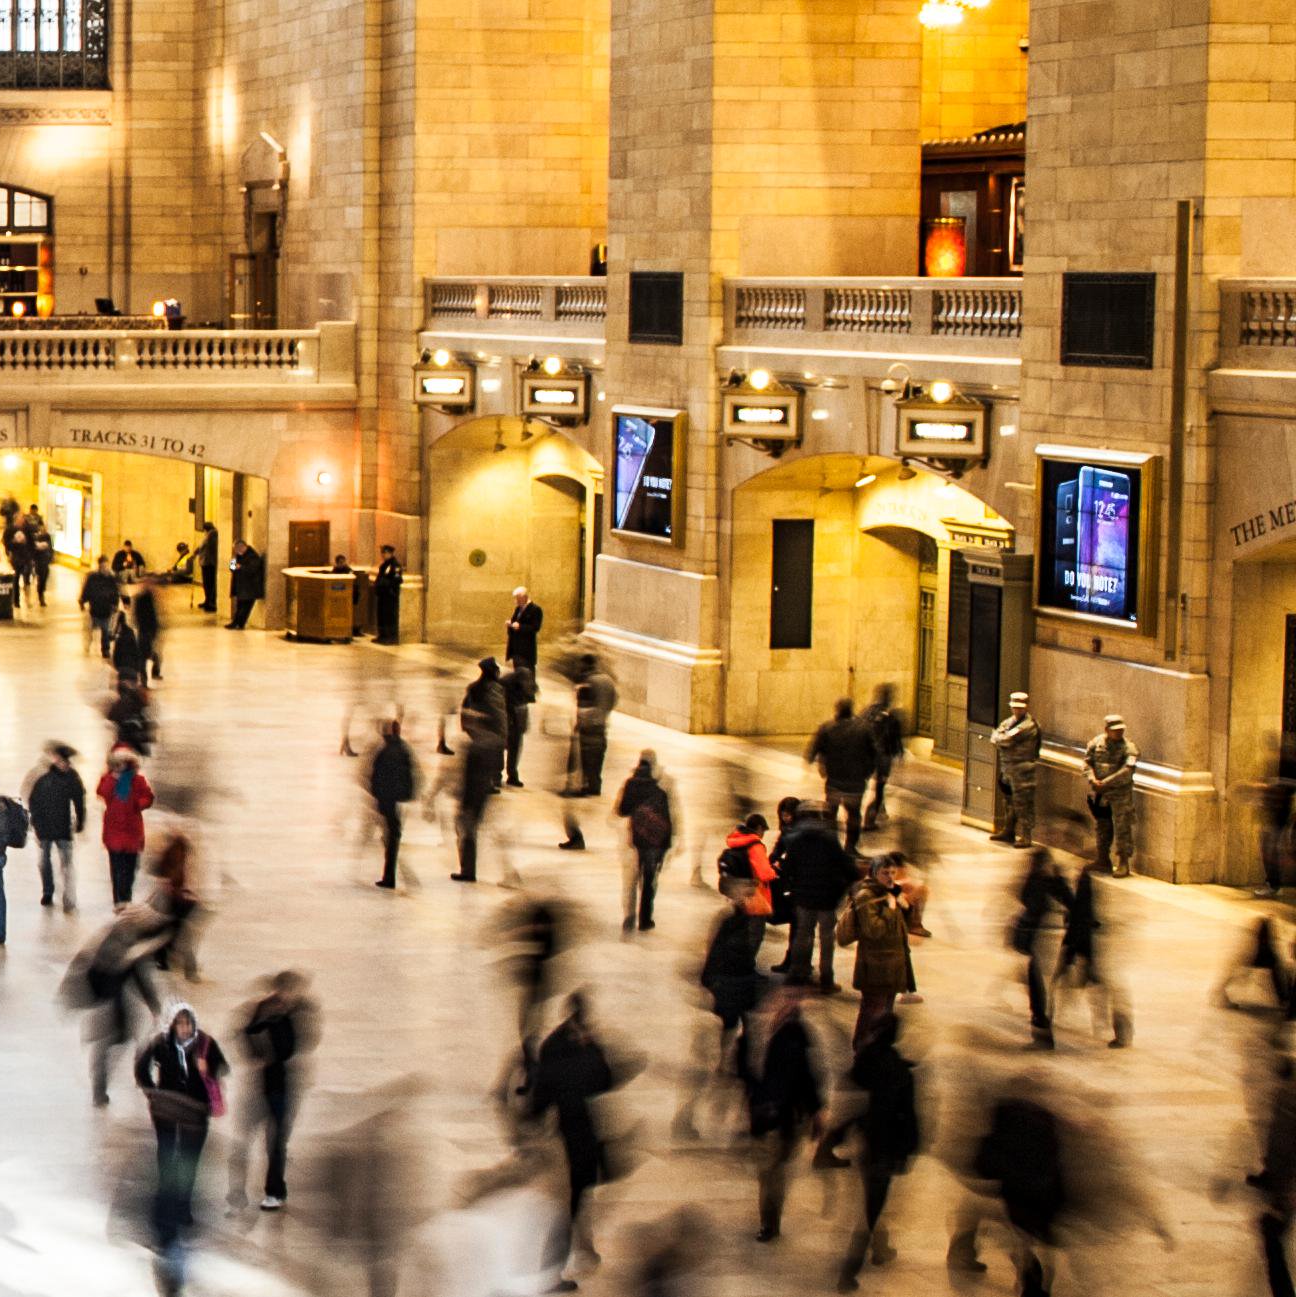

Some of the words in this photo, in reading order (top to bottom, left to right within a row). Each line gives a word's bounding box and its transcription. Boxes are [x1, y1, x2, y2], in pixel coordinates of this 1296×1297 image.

[70, 428, 137, 446] TRACKS
[140, 435, 156, 449] 31
[161, 437, 185, 453] TO
[188, 444, 206, 458] 42
[1230, 515, 1266, 546] THE
[1269, 500, 1296, 530] ME
[1064, 570, 1075, 586] DO
[1077, 571, 1092, 589] YOU
[1093, 575, 1118, 593] NOTE?
